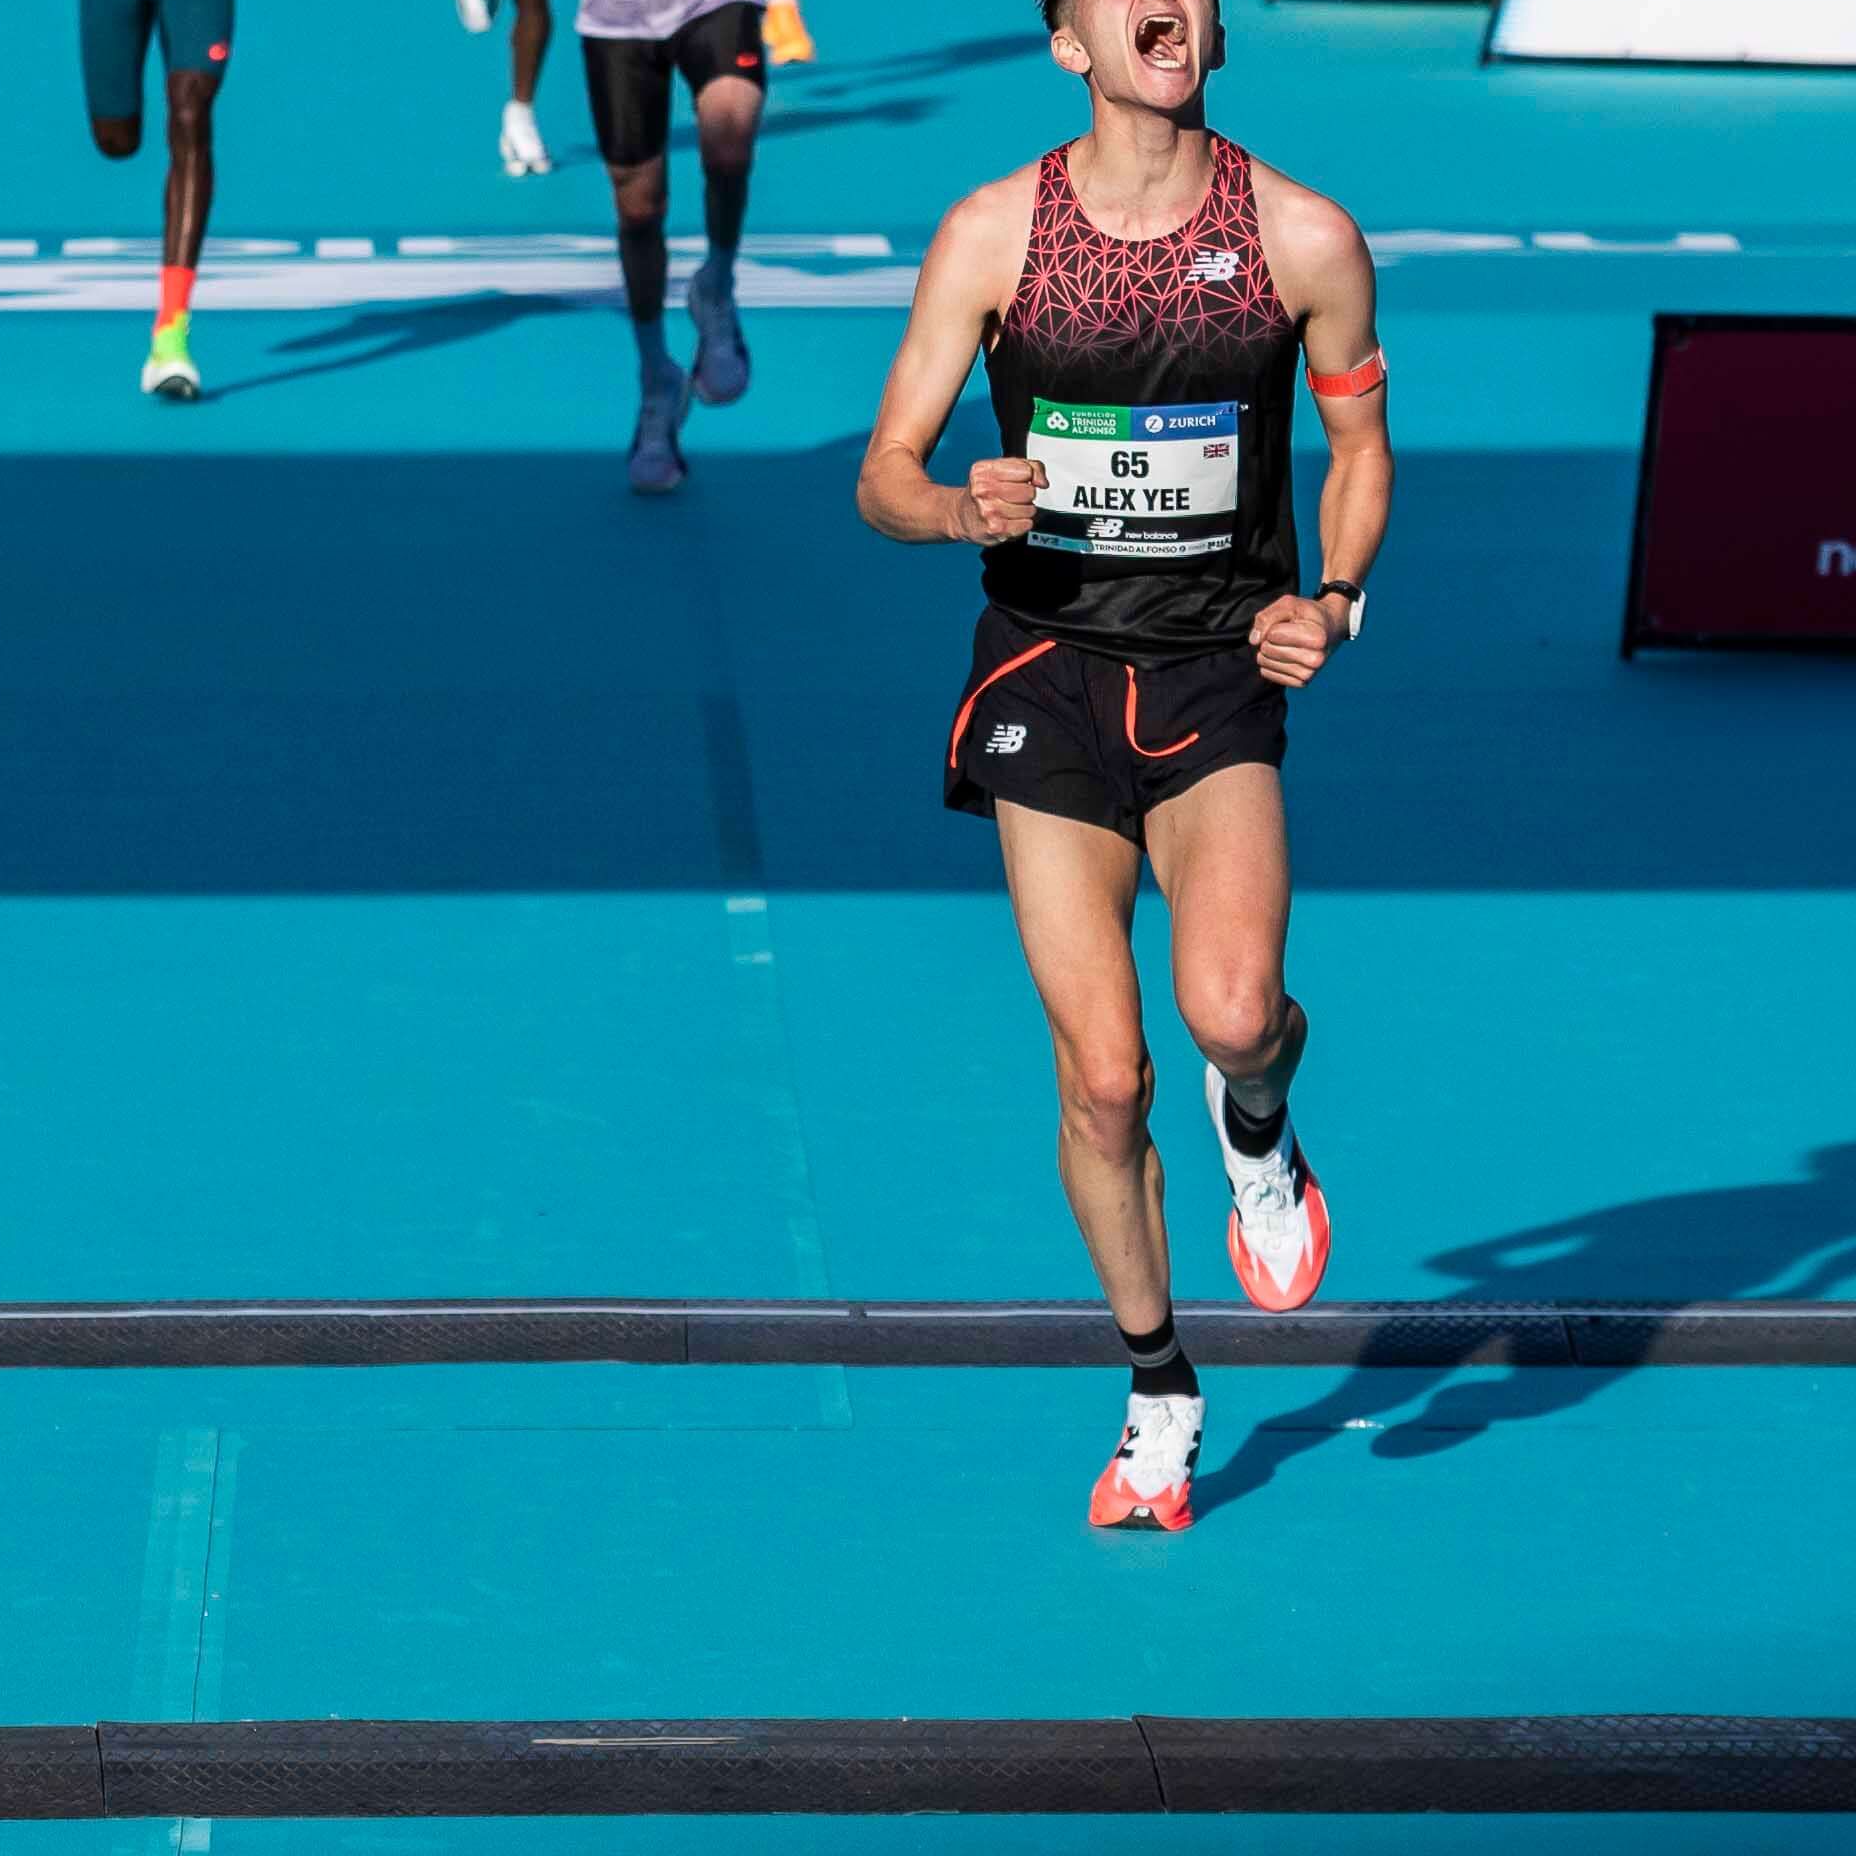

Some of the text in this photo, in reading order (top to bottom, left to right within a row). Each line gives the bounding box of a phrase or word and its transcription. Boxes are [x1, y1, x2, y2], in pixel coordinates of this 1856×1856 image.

[1071, 417, 1117, 428] TRINIDAD
[1168, 415, 1217, 429] ZURICH
[1071, 426, 1117, 436] ALFONSO
[1111, 451, 1149, 478] 65
[1073, 485, 1191, 511] ALEX YEE
[1095, 544, 1134, 553] TRINIDAD
[1136, 544, 1177, 554] ALFONSO
